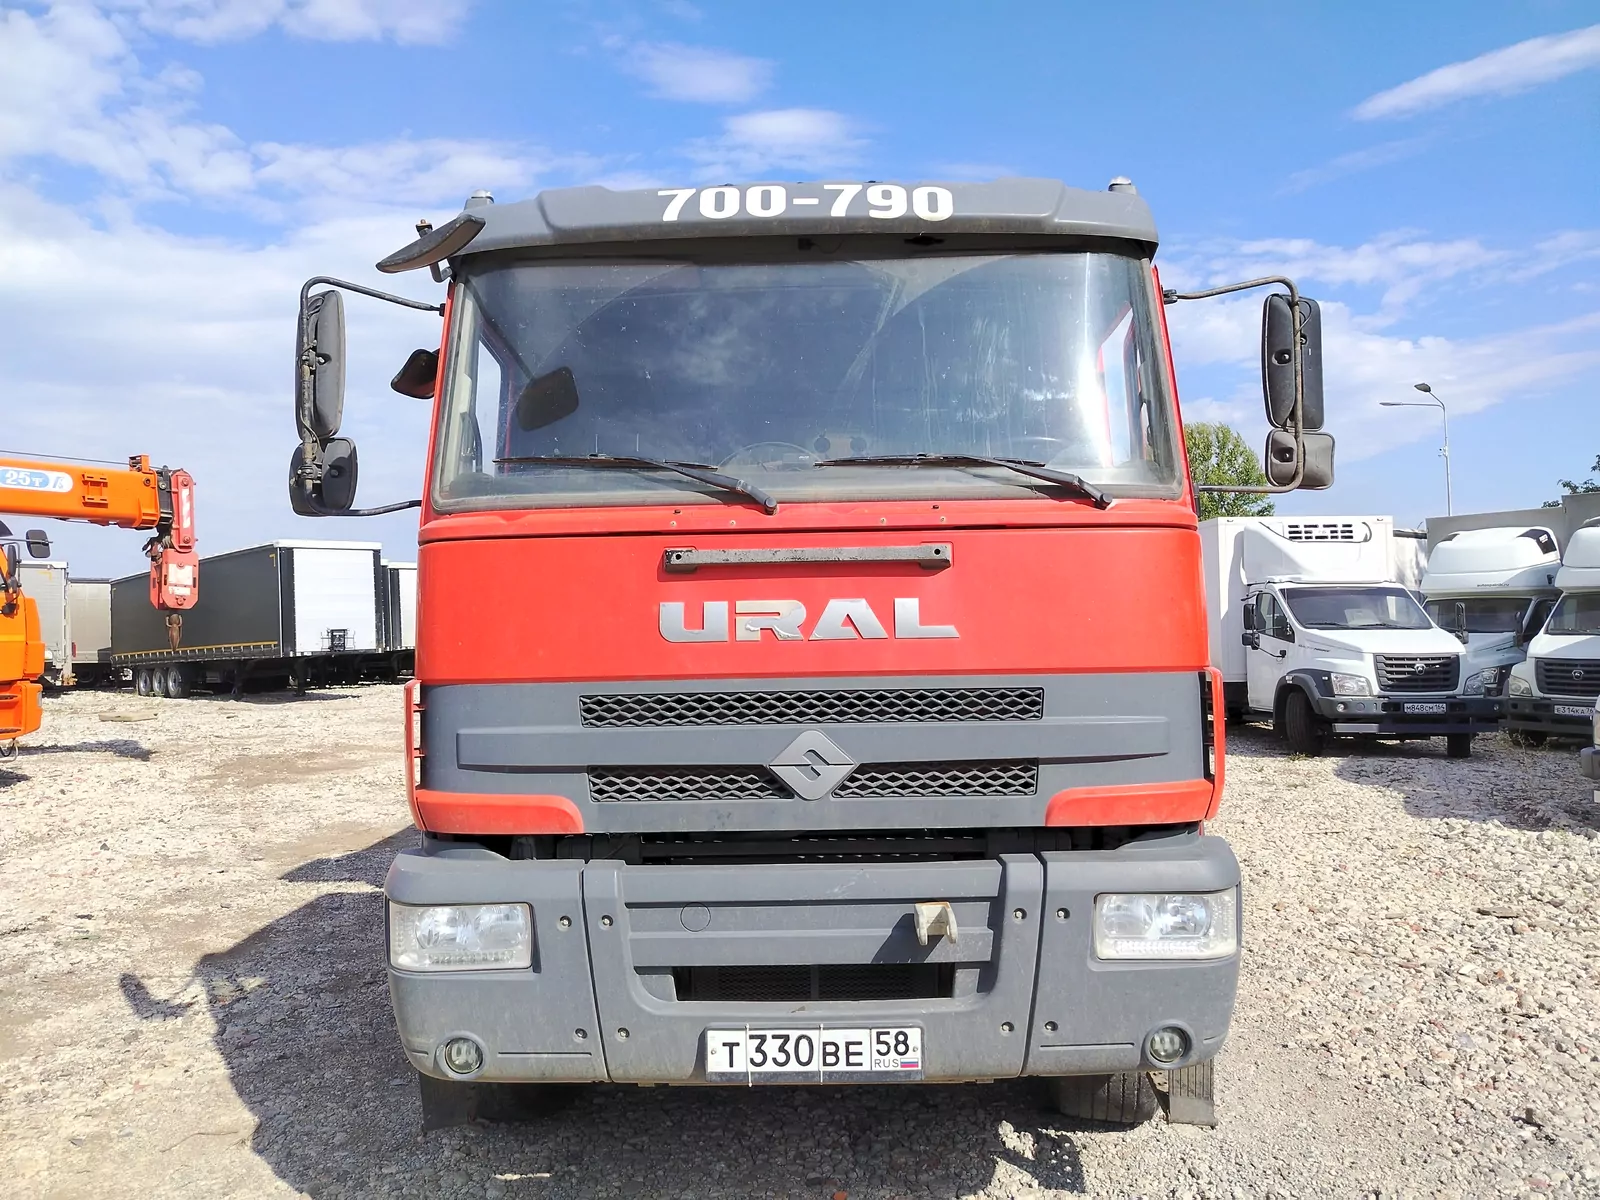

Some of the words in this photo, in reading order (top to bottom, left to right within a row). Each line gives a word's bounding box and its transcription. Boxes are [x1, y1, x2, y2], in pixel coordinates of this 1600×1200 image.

[657, 183, 954, 222] 700-790
[658, 597, 960, 643] URAL
[875, 1030, 910, 1057] 58
[874, 1058, 899, 1068] RUS
